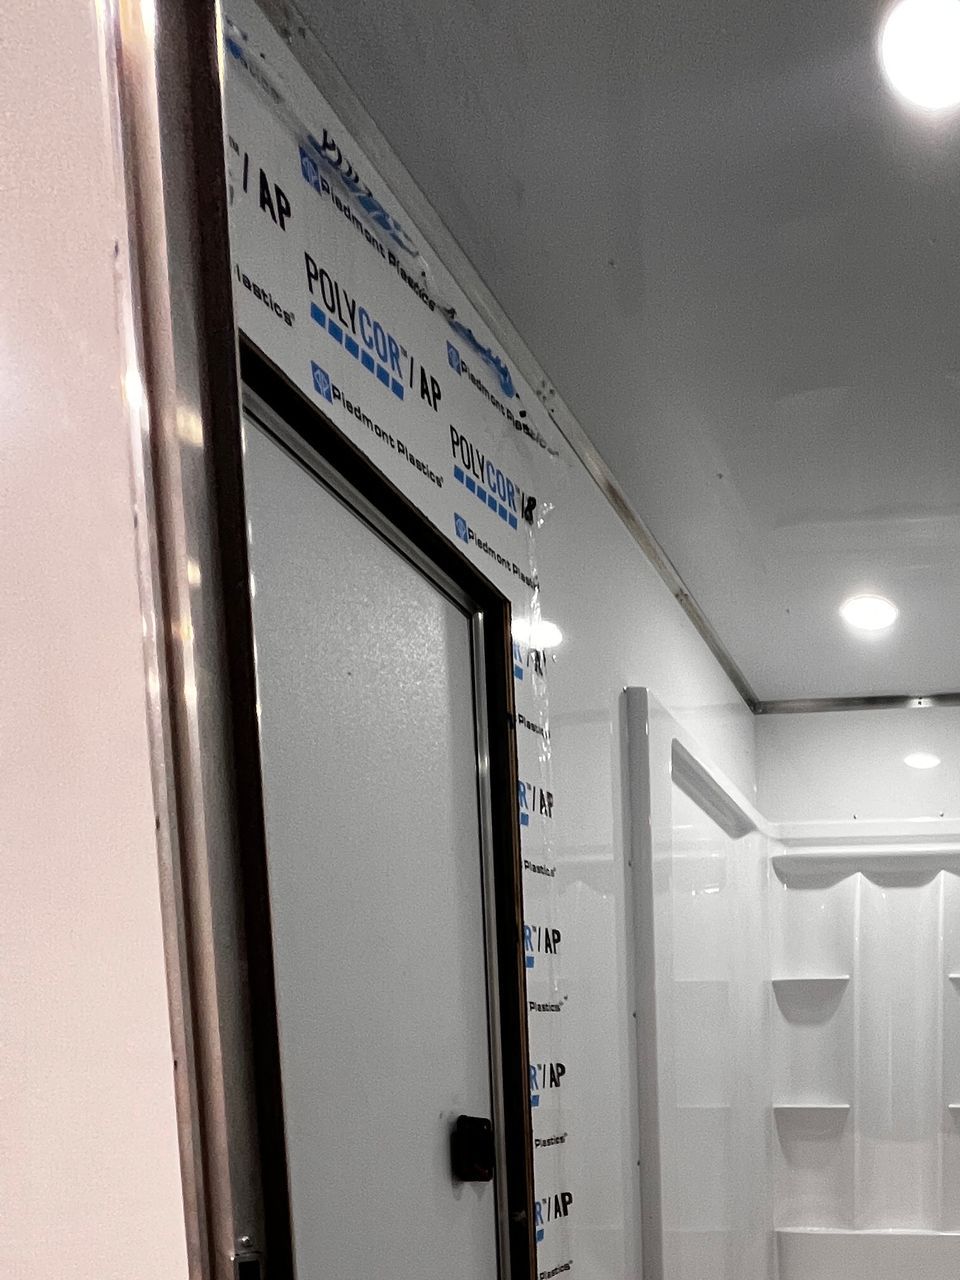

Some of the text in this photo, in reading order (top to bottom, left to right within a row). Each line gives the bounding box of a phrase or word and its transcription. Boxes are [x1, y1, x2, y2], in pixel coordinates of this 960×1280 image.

[259, 168, 292, 232] AP
[320, 175, 386, 259] Piedmont
[235, 263, 295, 328] lastics
[420, 365, 442, 413] AP
[332, 384, 395, 449] Piedmont
[467, 527, 511, 572] Piedmont
[544, 927, 561, 954] AP
[549, 1063, 566, 1088] AP
[554, 1192, 573, 1219] AP
